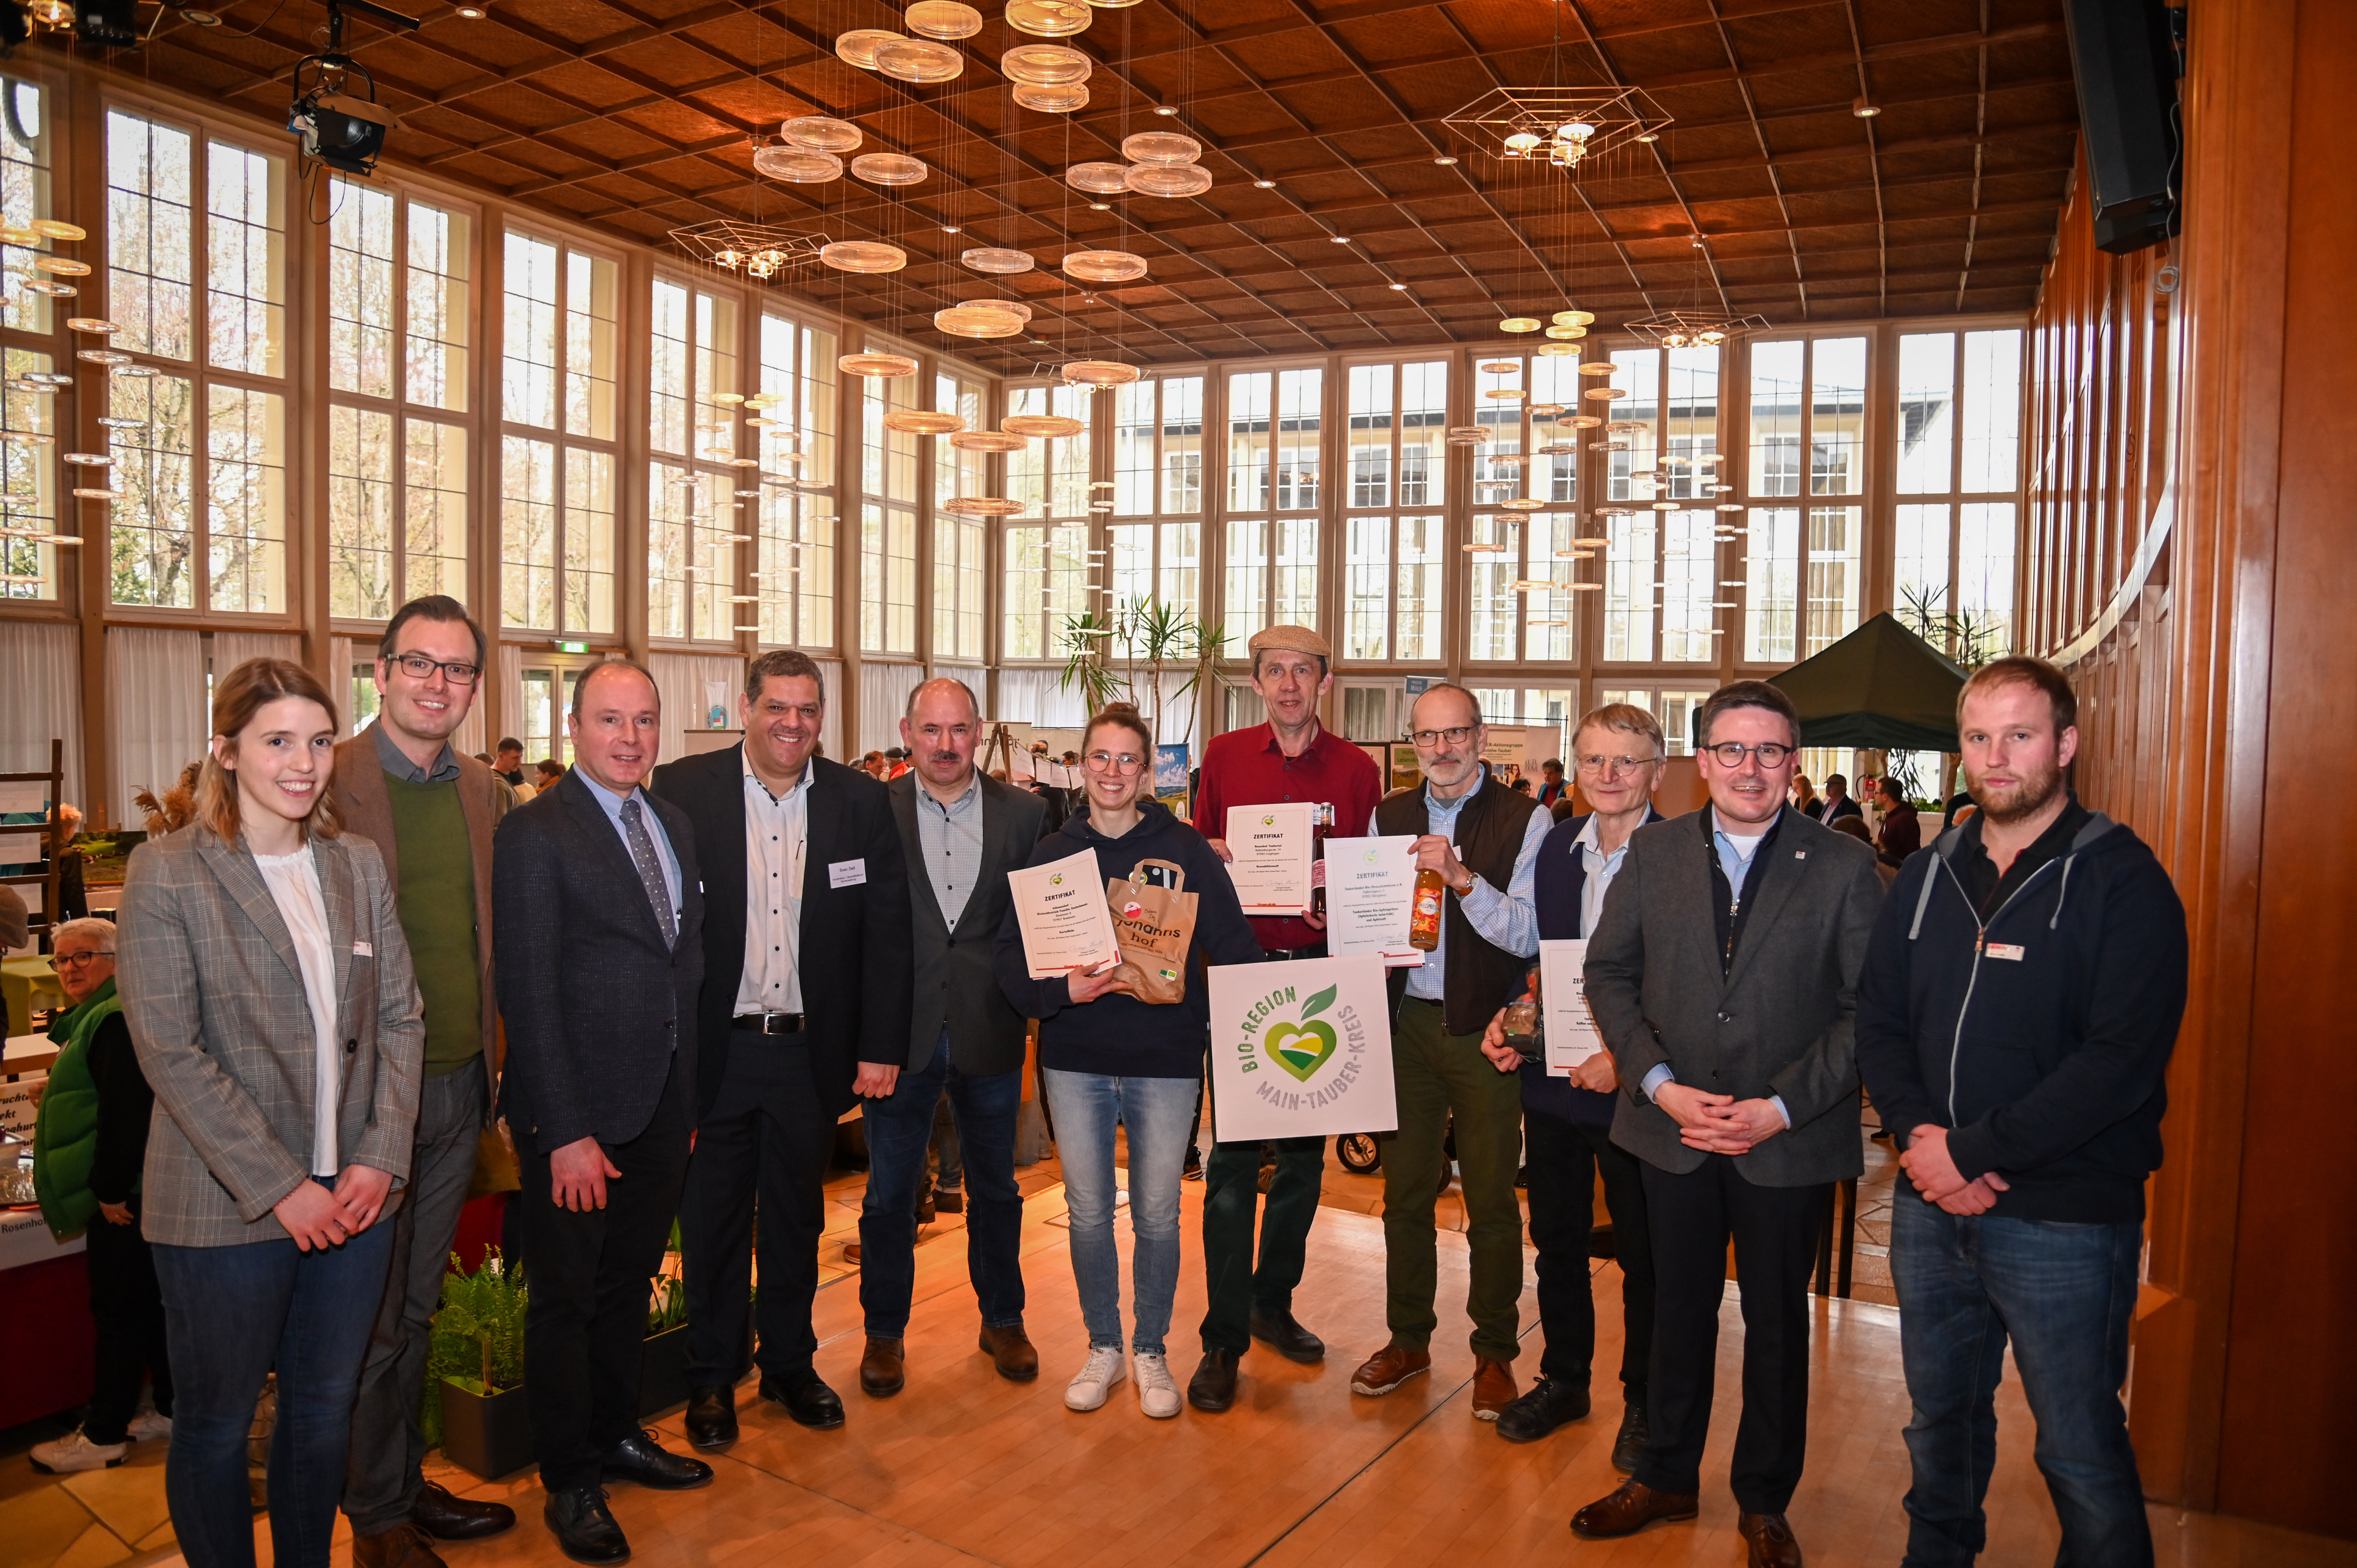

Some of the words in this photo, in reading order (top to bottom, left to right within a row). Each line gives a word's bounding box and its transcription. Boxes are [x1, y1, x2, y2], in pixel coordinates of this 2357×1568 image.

[1044, 890, 1075, 901] ZERTIFIKAT
[1130, 932, 1158, 948] hof
[1238, 985, 1296, 1074] BIO-REGION
[1256, 1005, 1365, 1110] MAIN-TAUBER-KREIS
